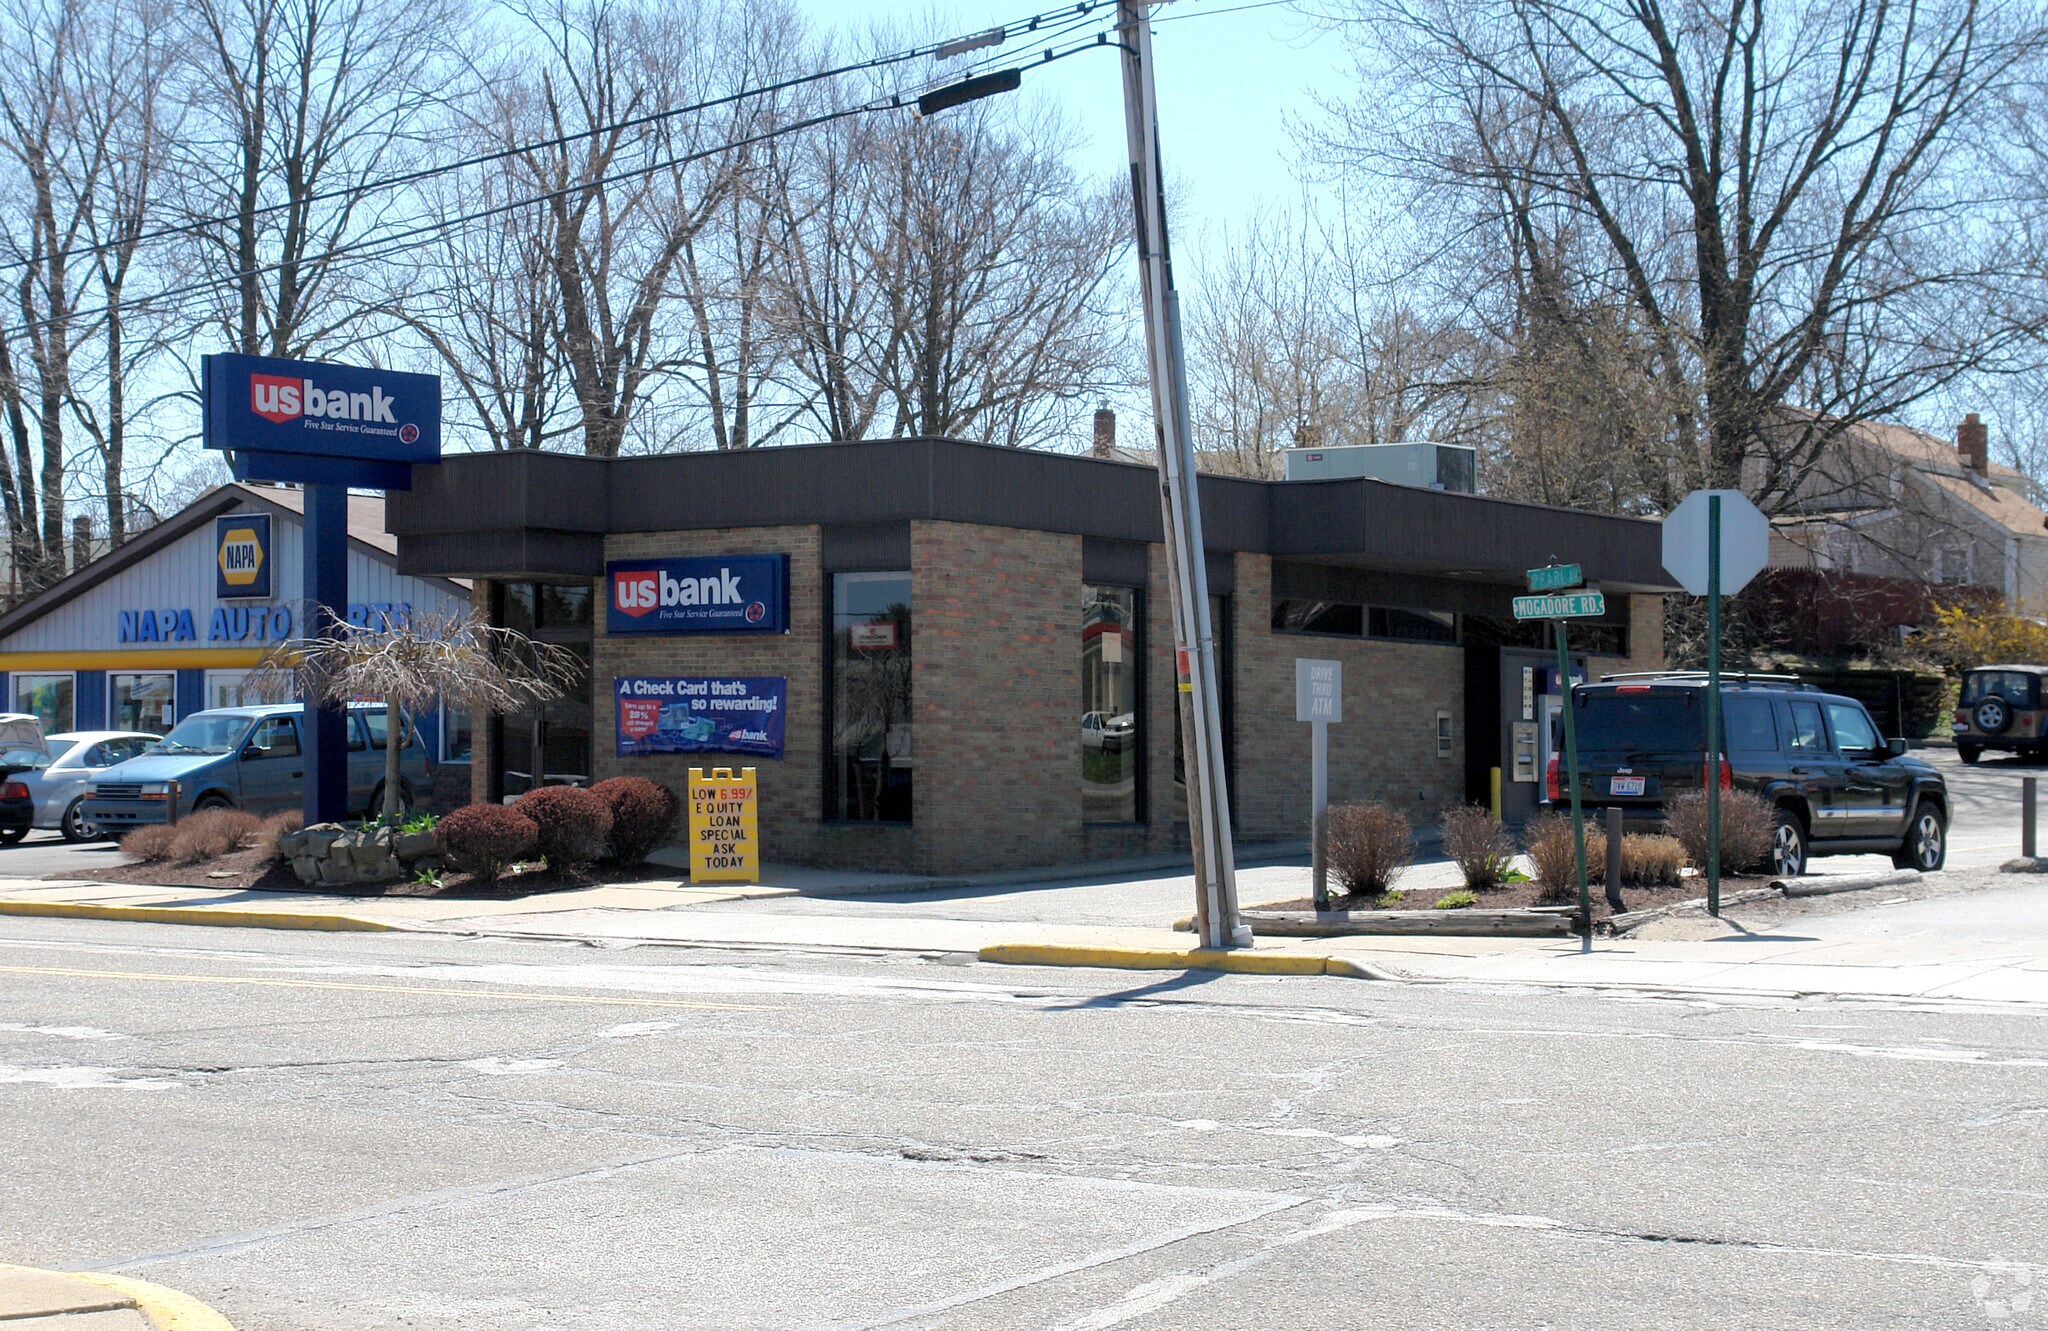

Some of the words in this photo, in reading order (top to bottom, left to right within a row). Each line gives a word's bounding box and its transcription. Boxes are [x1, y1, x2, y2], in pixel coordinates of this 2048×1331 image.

[304, 420, 319, 430] Five
[320, 421, 334, 431] Star
[335, 422, 360, 433] Service
[360, 424, 398, 436] Guaranteed
[226, 544, 255, 570] NAPA
[1518, 598, 1576, 616] MOGADORE
[1581, 596, 1600, 613] RD.
[659, 610, 673, 619] Five
[673, 610, 685, 619] Star
[686, 608, 708, 619] Service
[708, 608, 744, 618] Guaranteed
[118, 608, 196, 643] NAPA
[208, 606, 292, 641] AUTO
[1310, 667, 1333, 681] DRIVE
[619, 680, 631, 694] A
[633, 680, 674, 695] Check
[677, 681, 708, 695] Card
[711, 681, 747, 696] that's
[1312, 682, 1332, 696] THRU
[691, 698, 707, 710] so
[710, 696, 778, 713] rewarding!
[1311, 698, 1332, 715] ATM
[692, 789, 716, 800] LOW
[720, 788, 753, 800] 6.99%
[696, 803, 743, 813] EQUITY
[710, 816, 740, 827] LOAN
[701, 830, 746, 841] SPECIAL
[713, 843, 736, 854] ASK
[705, 857, 743, 868] TODAY
